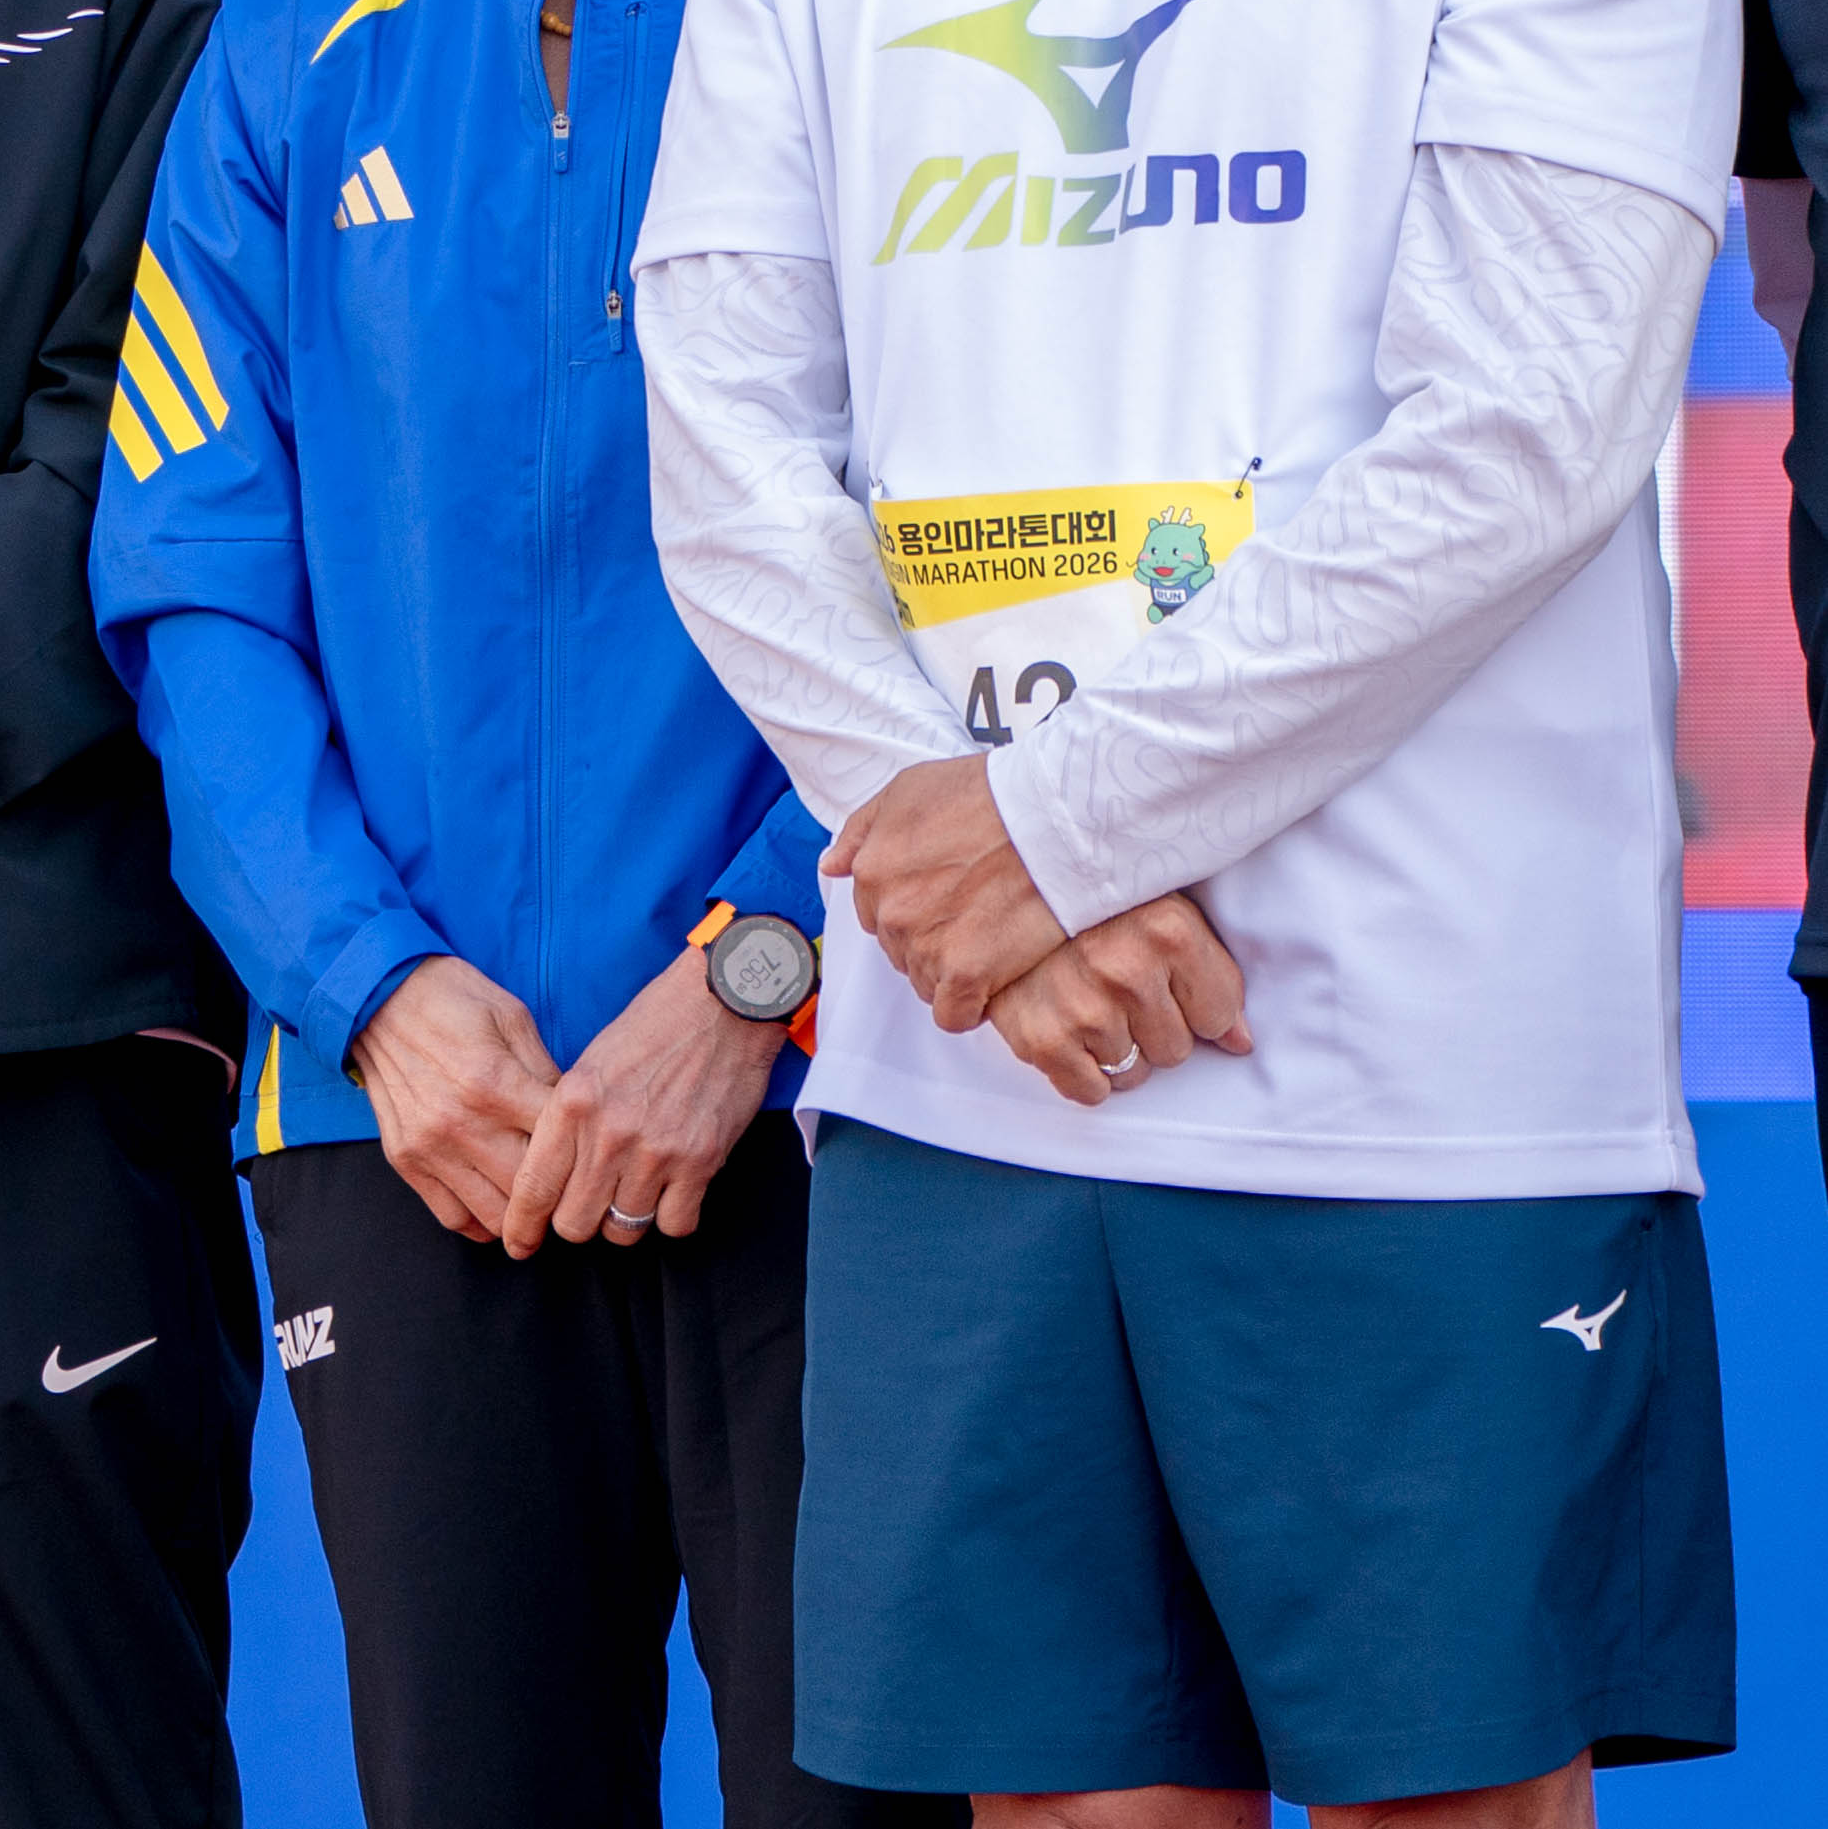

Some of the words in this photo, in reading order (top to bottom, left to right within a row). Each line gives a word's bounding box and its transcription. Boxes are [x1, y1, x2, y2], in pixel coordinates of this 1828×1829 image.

[897, 509, 1117, 556] 용인마라톤대회
[912, 555, 1046, 587] MARATHON
[1054, 551, 1118, 577] 2026
[1155, 590, 1183, 602] RUN
